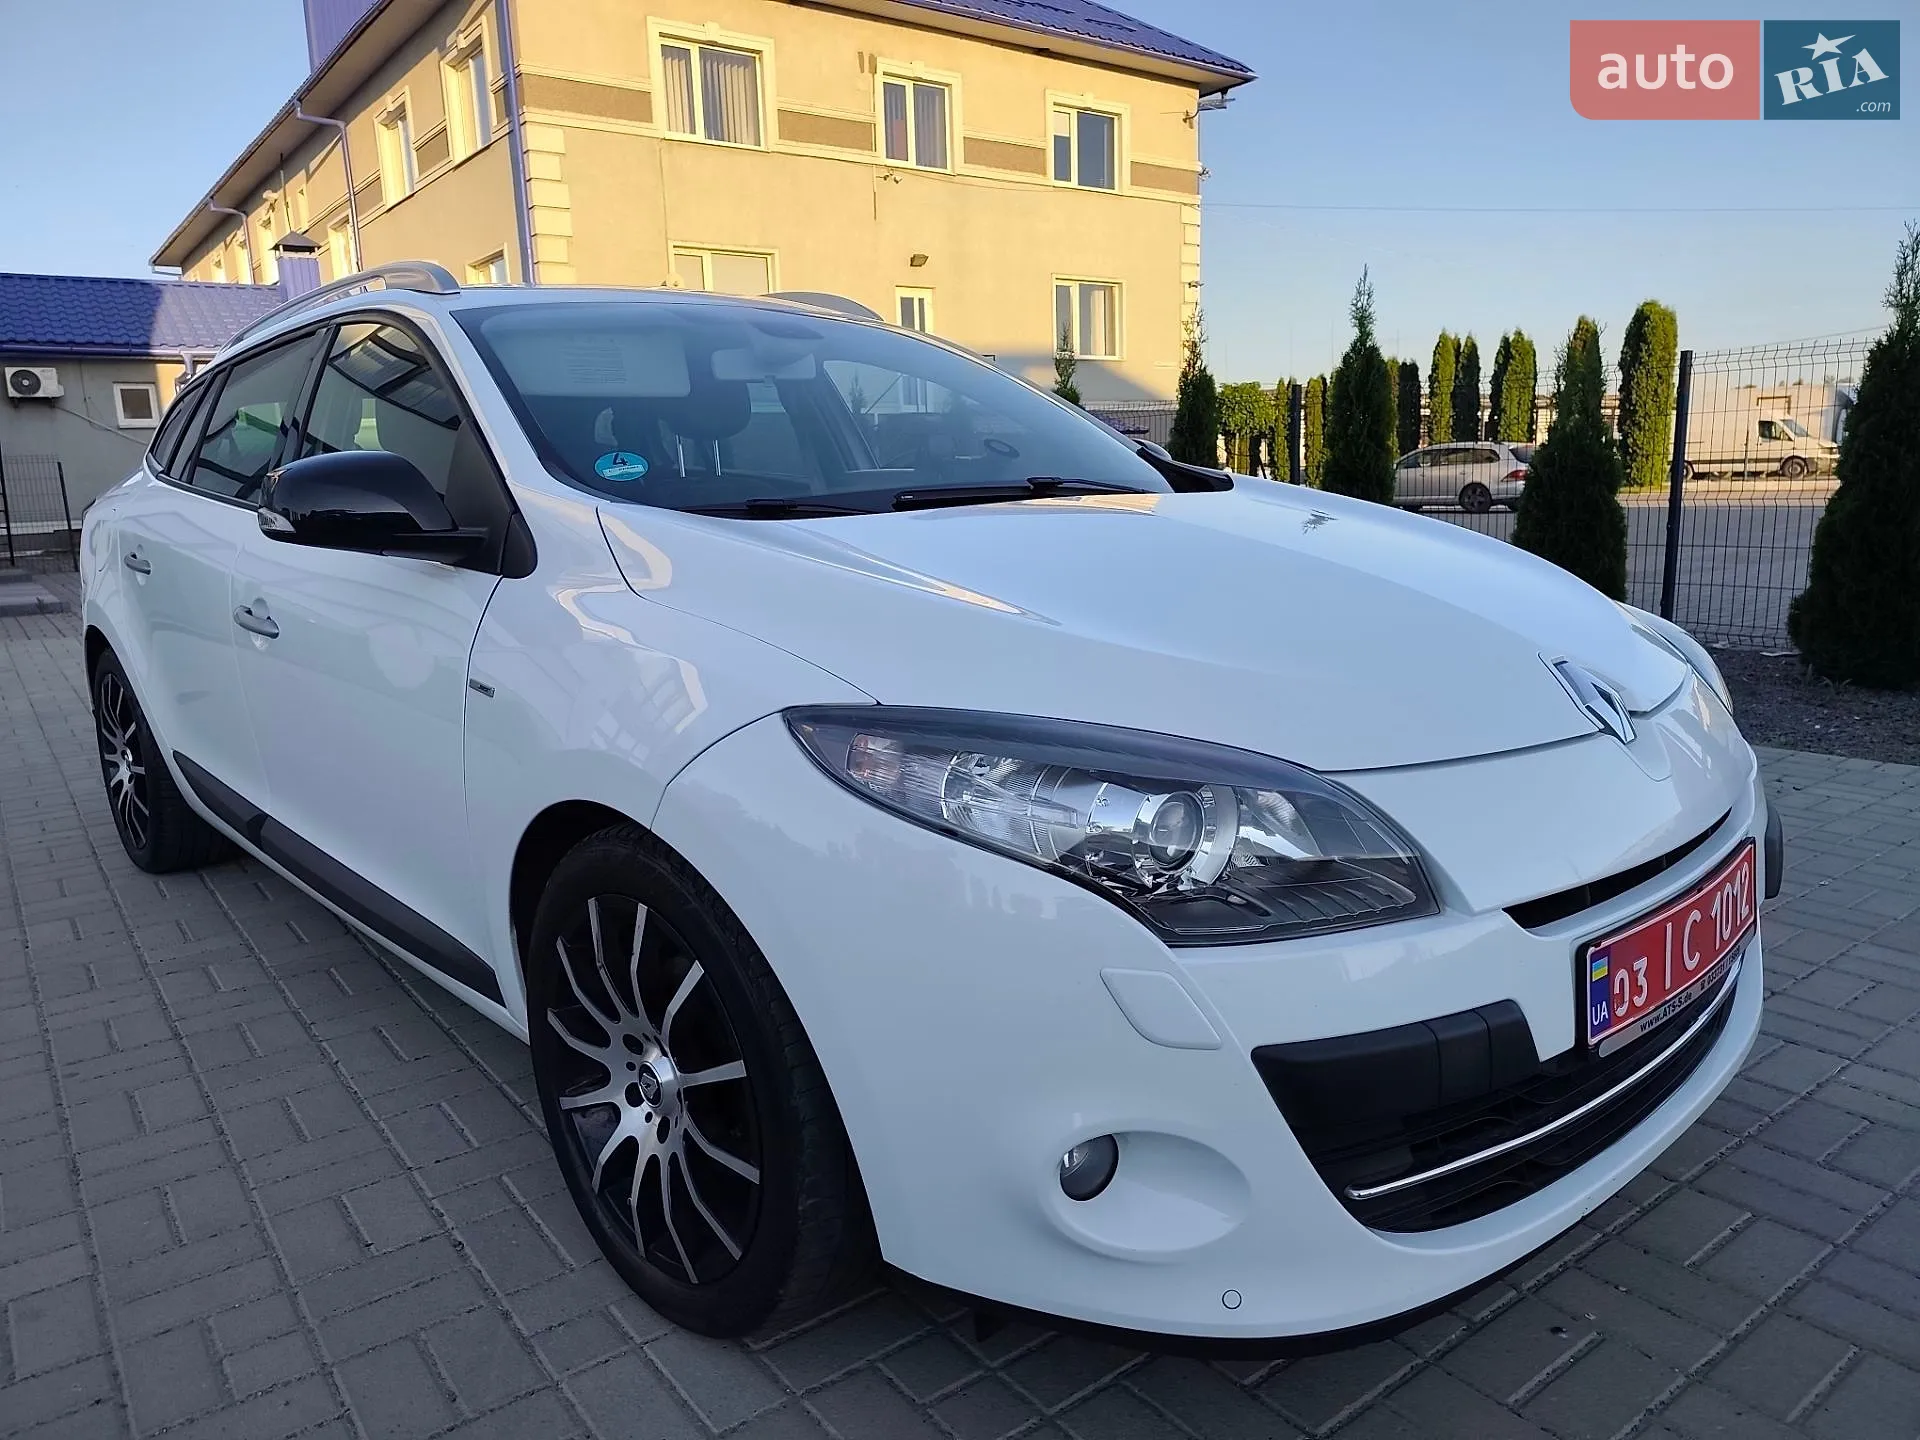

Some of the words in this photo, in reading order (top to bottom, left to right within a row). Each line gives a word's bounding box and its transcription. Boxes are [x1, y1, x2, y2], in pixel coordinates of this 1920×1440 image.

[612, 452, 629, 466] 4
[1614, 956, 1648, 1017] 03
[1711, 862, 1750, 951] 1012
[1592, 1001, 1609, 1026] UA
